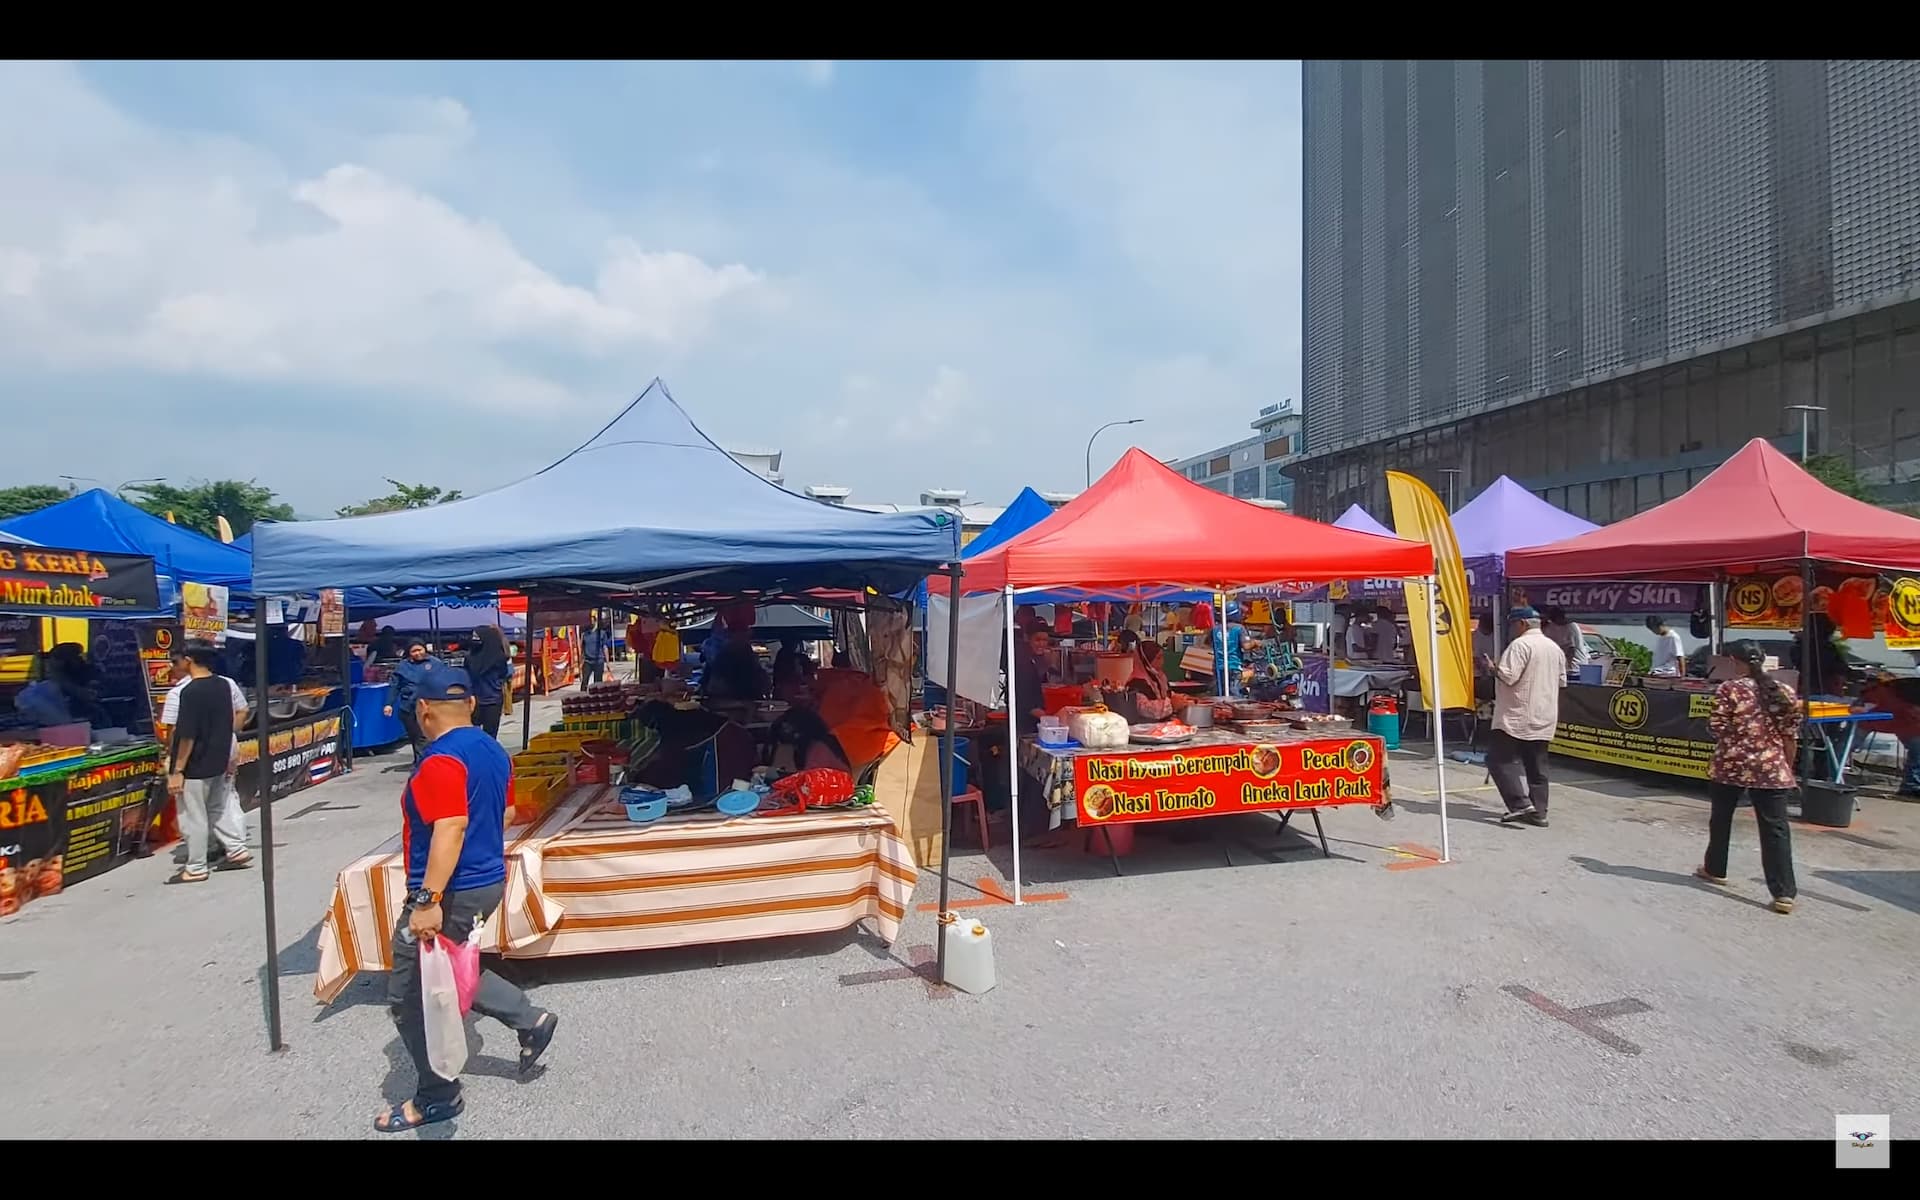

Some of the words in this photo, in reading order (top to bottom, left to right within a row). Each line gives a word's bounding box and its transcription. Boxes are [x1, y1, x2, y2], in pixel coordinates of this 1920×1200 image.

[4, 581, 95, 606] Murtabak
[1628, 584, 1681, 604] Skin
[1088, 760, 1123, 781] Nasi
[1174, 749, 1251, 775] Berempah
[1302, 748, 1346, 770] Pecal
[1114, 793, 1151, 814] Nasi
[1156, 786, 1216, 811] Tomato
[1242, 781, 1290, 804] Aneka
[1295, 779, 1331, 800] Lauk
[1335, 777, 1372, 798] Pauk
